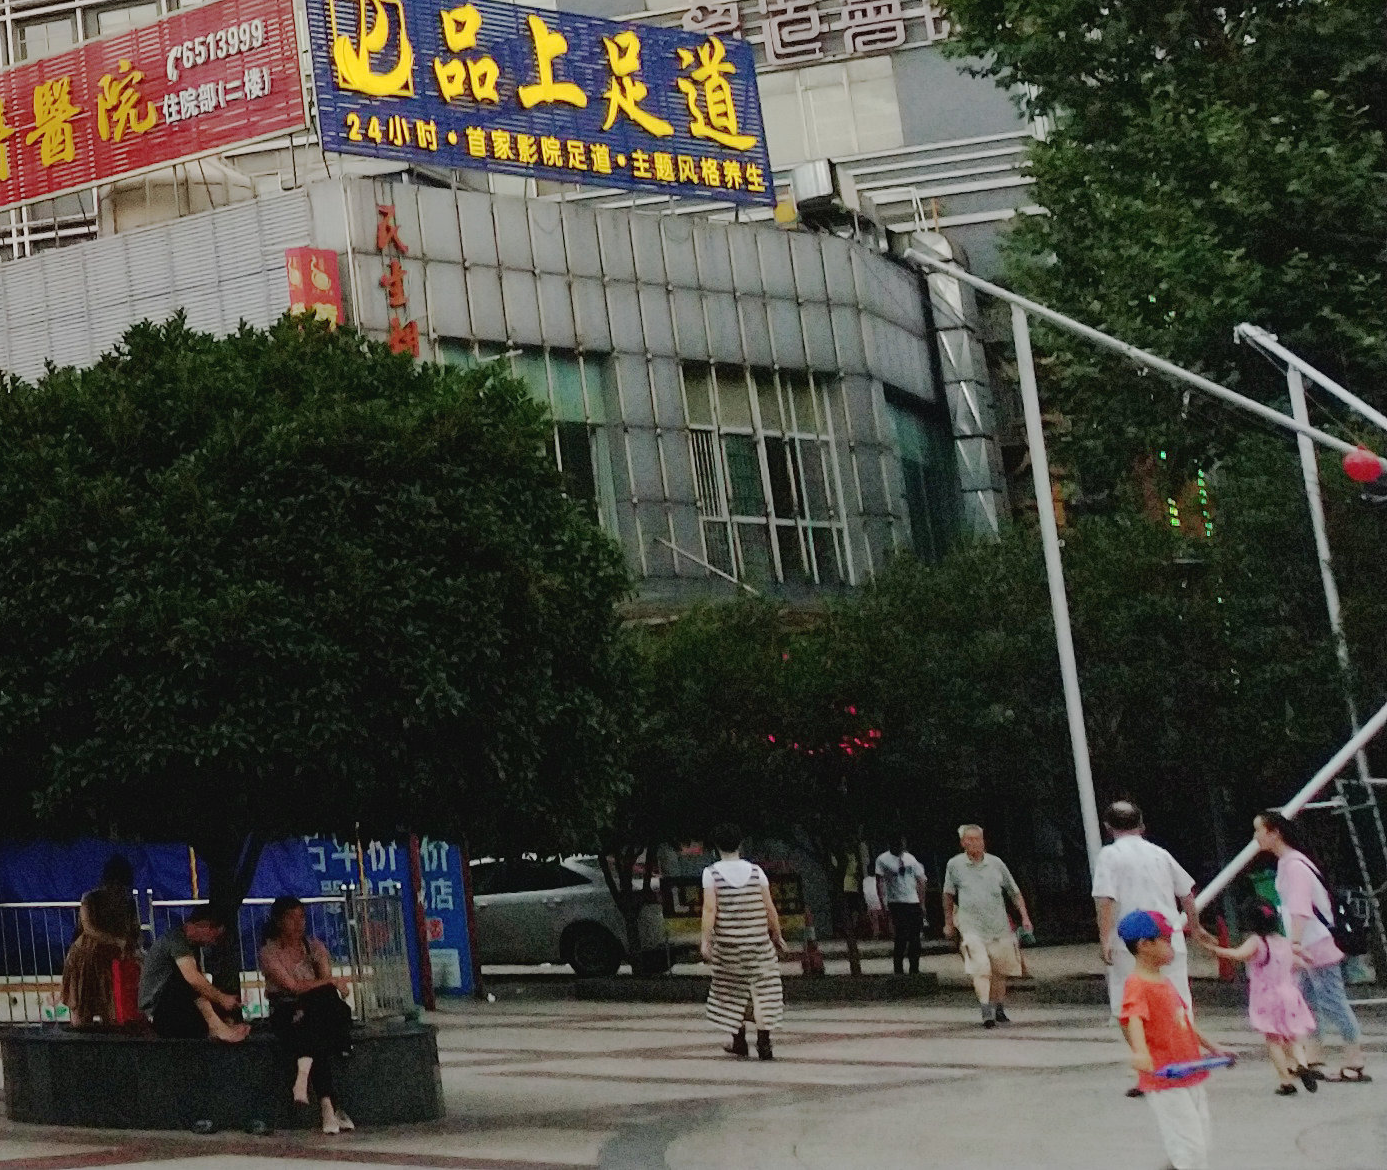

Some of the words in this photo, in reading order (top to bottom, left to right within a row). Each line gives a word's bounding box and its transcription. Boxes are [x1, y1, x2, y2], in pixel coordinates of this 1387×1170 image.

[180, 19, 266, 70] 6513999
[433, 2, 759, 151] 品上足道
